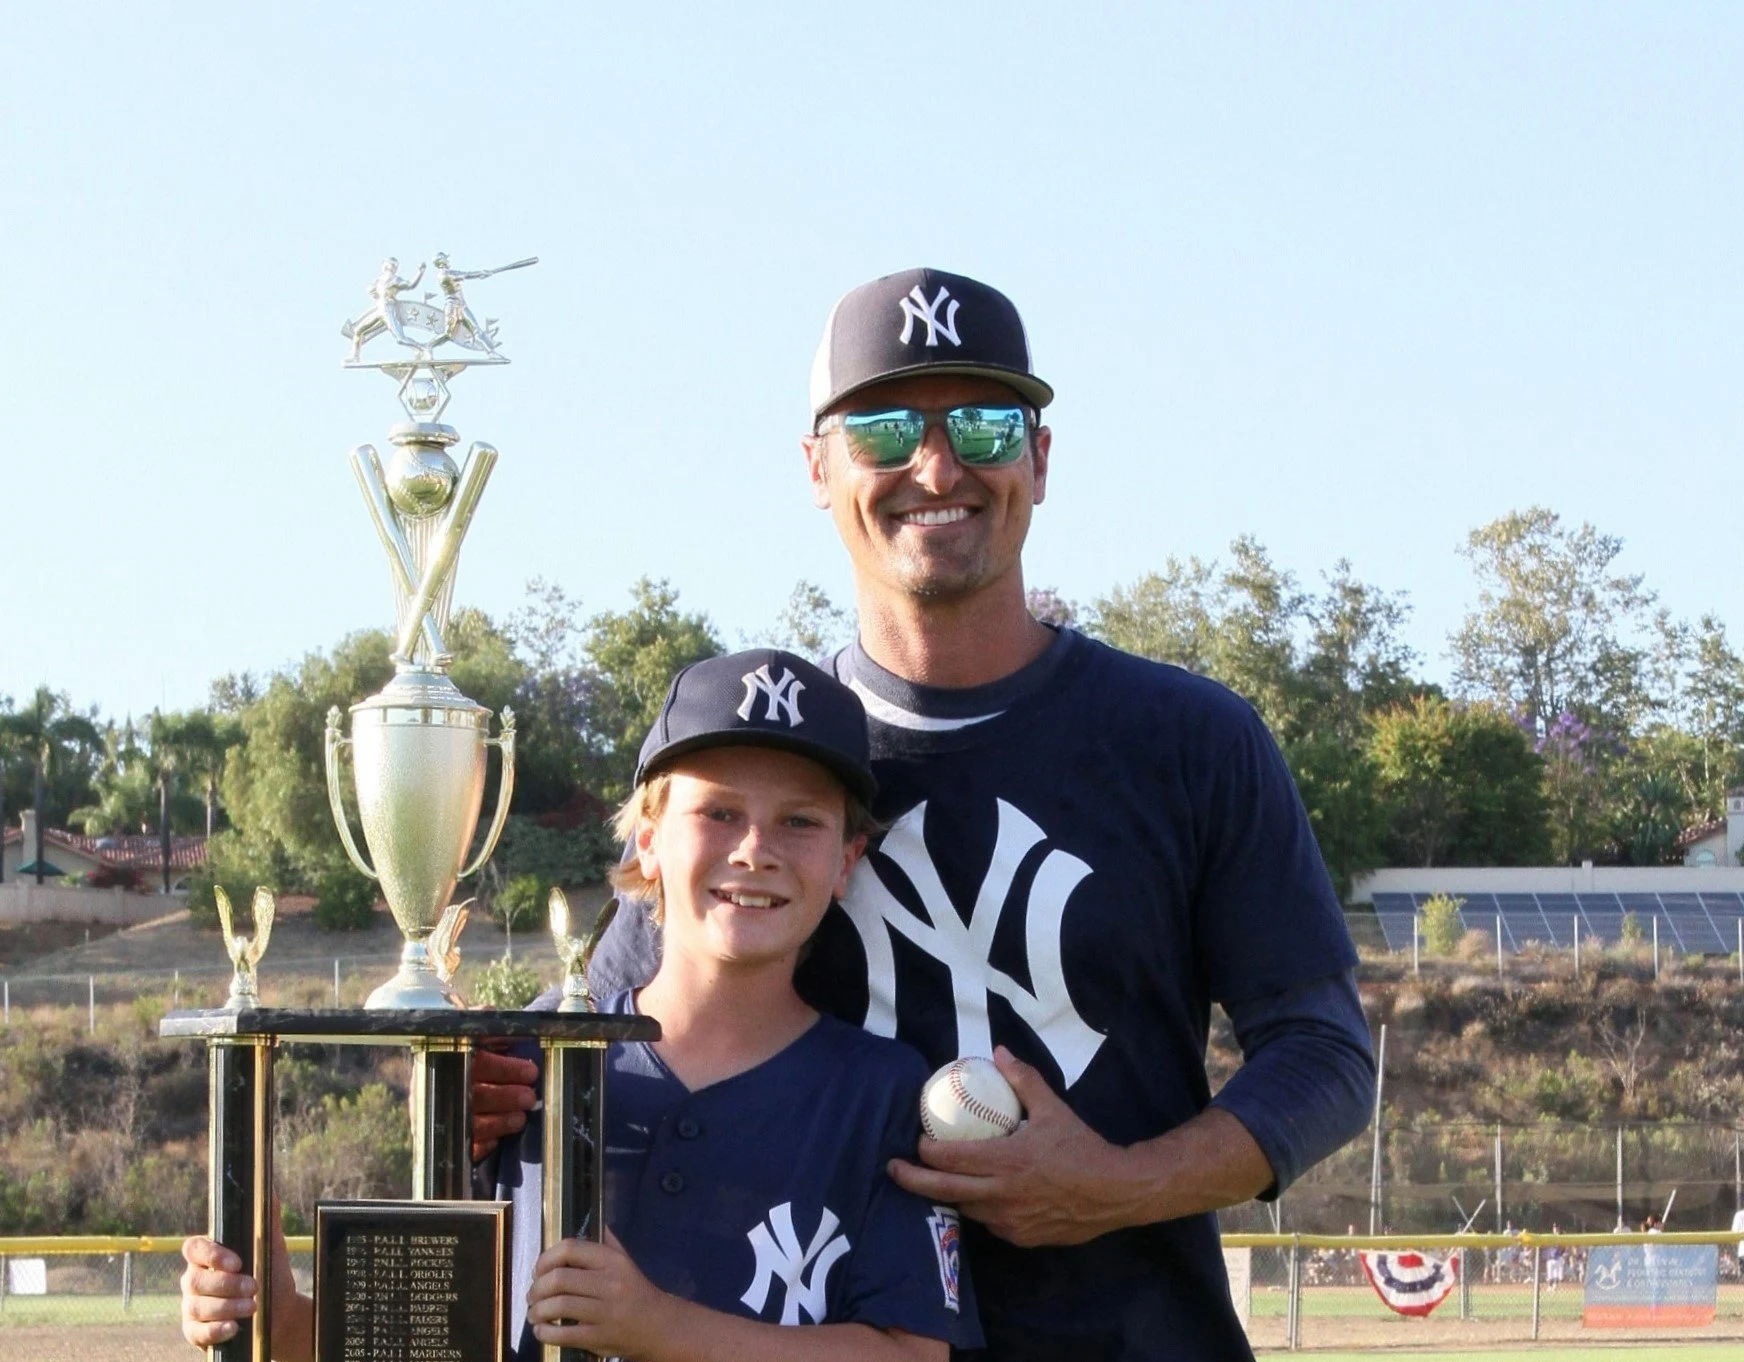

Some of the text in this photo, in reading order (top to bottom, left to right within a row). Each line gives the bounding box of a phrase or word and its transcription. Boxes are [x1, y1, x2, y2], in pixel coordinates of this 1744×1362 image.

[346, 1235, 366, 1245] 15
[410, 1235, 459, 1245] BREWERS
[346, 1247, 366, 1256] 19
[408, 1247, 455, 1256] YANKEES
[346, 1258, 366, 1267] 197
[410, 1269, 453, 1279] ORIOLES
[410, 1281, 450, 1290] ANGELS
[345, 1292, 366, 1301] 200
[410, 1292, 458, 1301] DODGERS
[410, 1303, 449, 1313] PADRES
[410, 1326, 450, 1335] ANGELS
[409, 1337, 449, 1347] ANGELS
[344, 1349, 365, 1358] 2005
[409, 1349, 462, 1358] MARINERS
